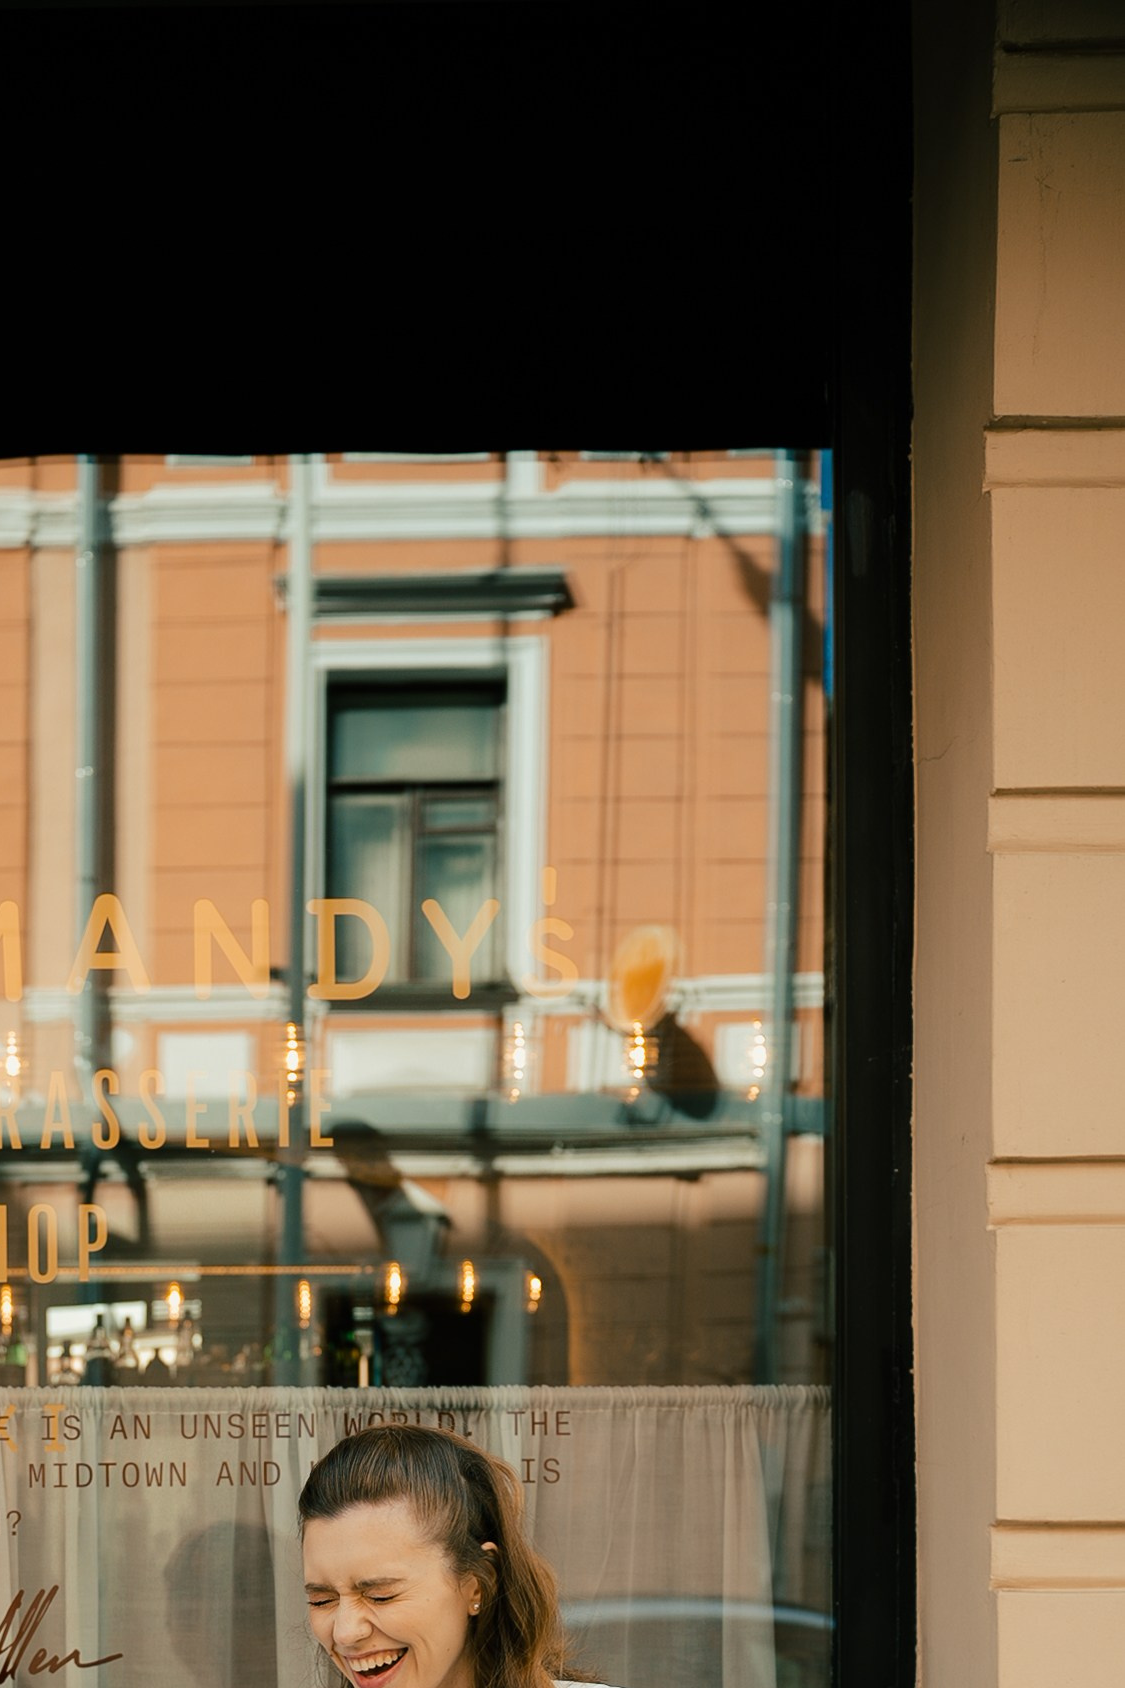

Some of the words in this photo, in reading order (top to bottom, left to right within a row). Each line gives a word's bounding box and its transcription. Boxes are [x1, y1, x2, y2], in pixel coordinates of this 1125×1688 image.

[41, 1415, 82, 1441] IS
[109, 1414, 151, 1440] AN
[180, 1413, 316, 1440] UNSEEN
[506, 1410, 572, 1436] THE
[28, 1461, 187, 1488] MIDTOWN
[215, 1460, 282, 1487] AND
[521, 1458, 561, 1484] IS
